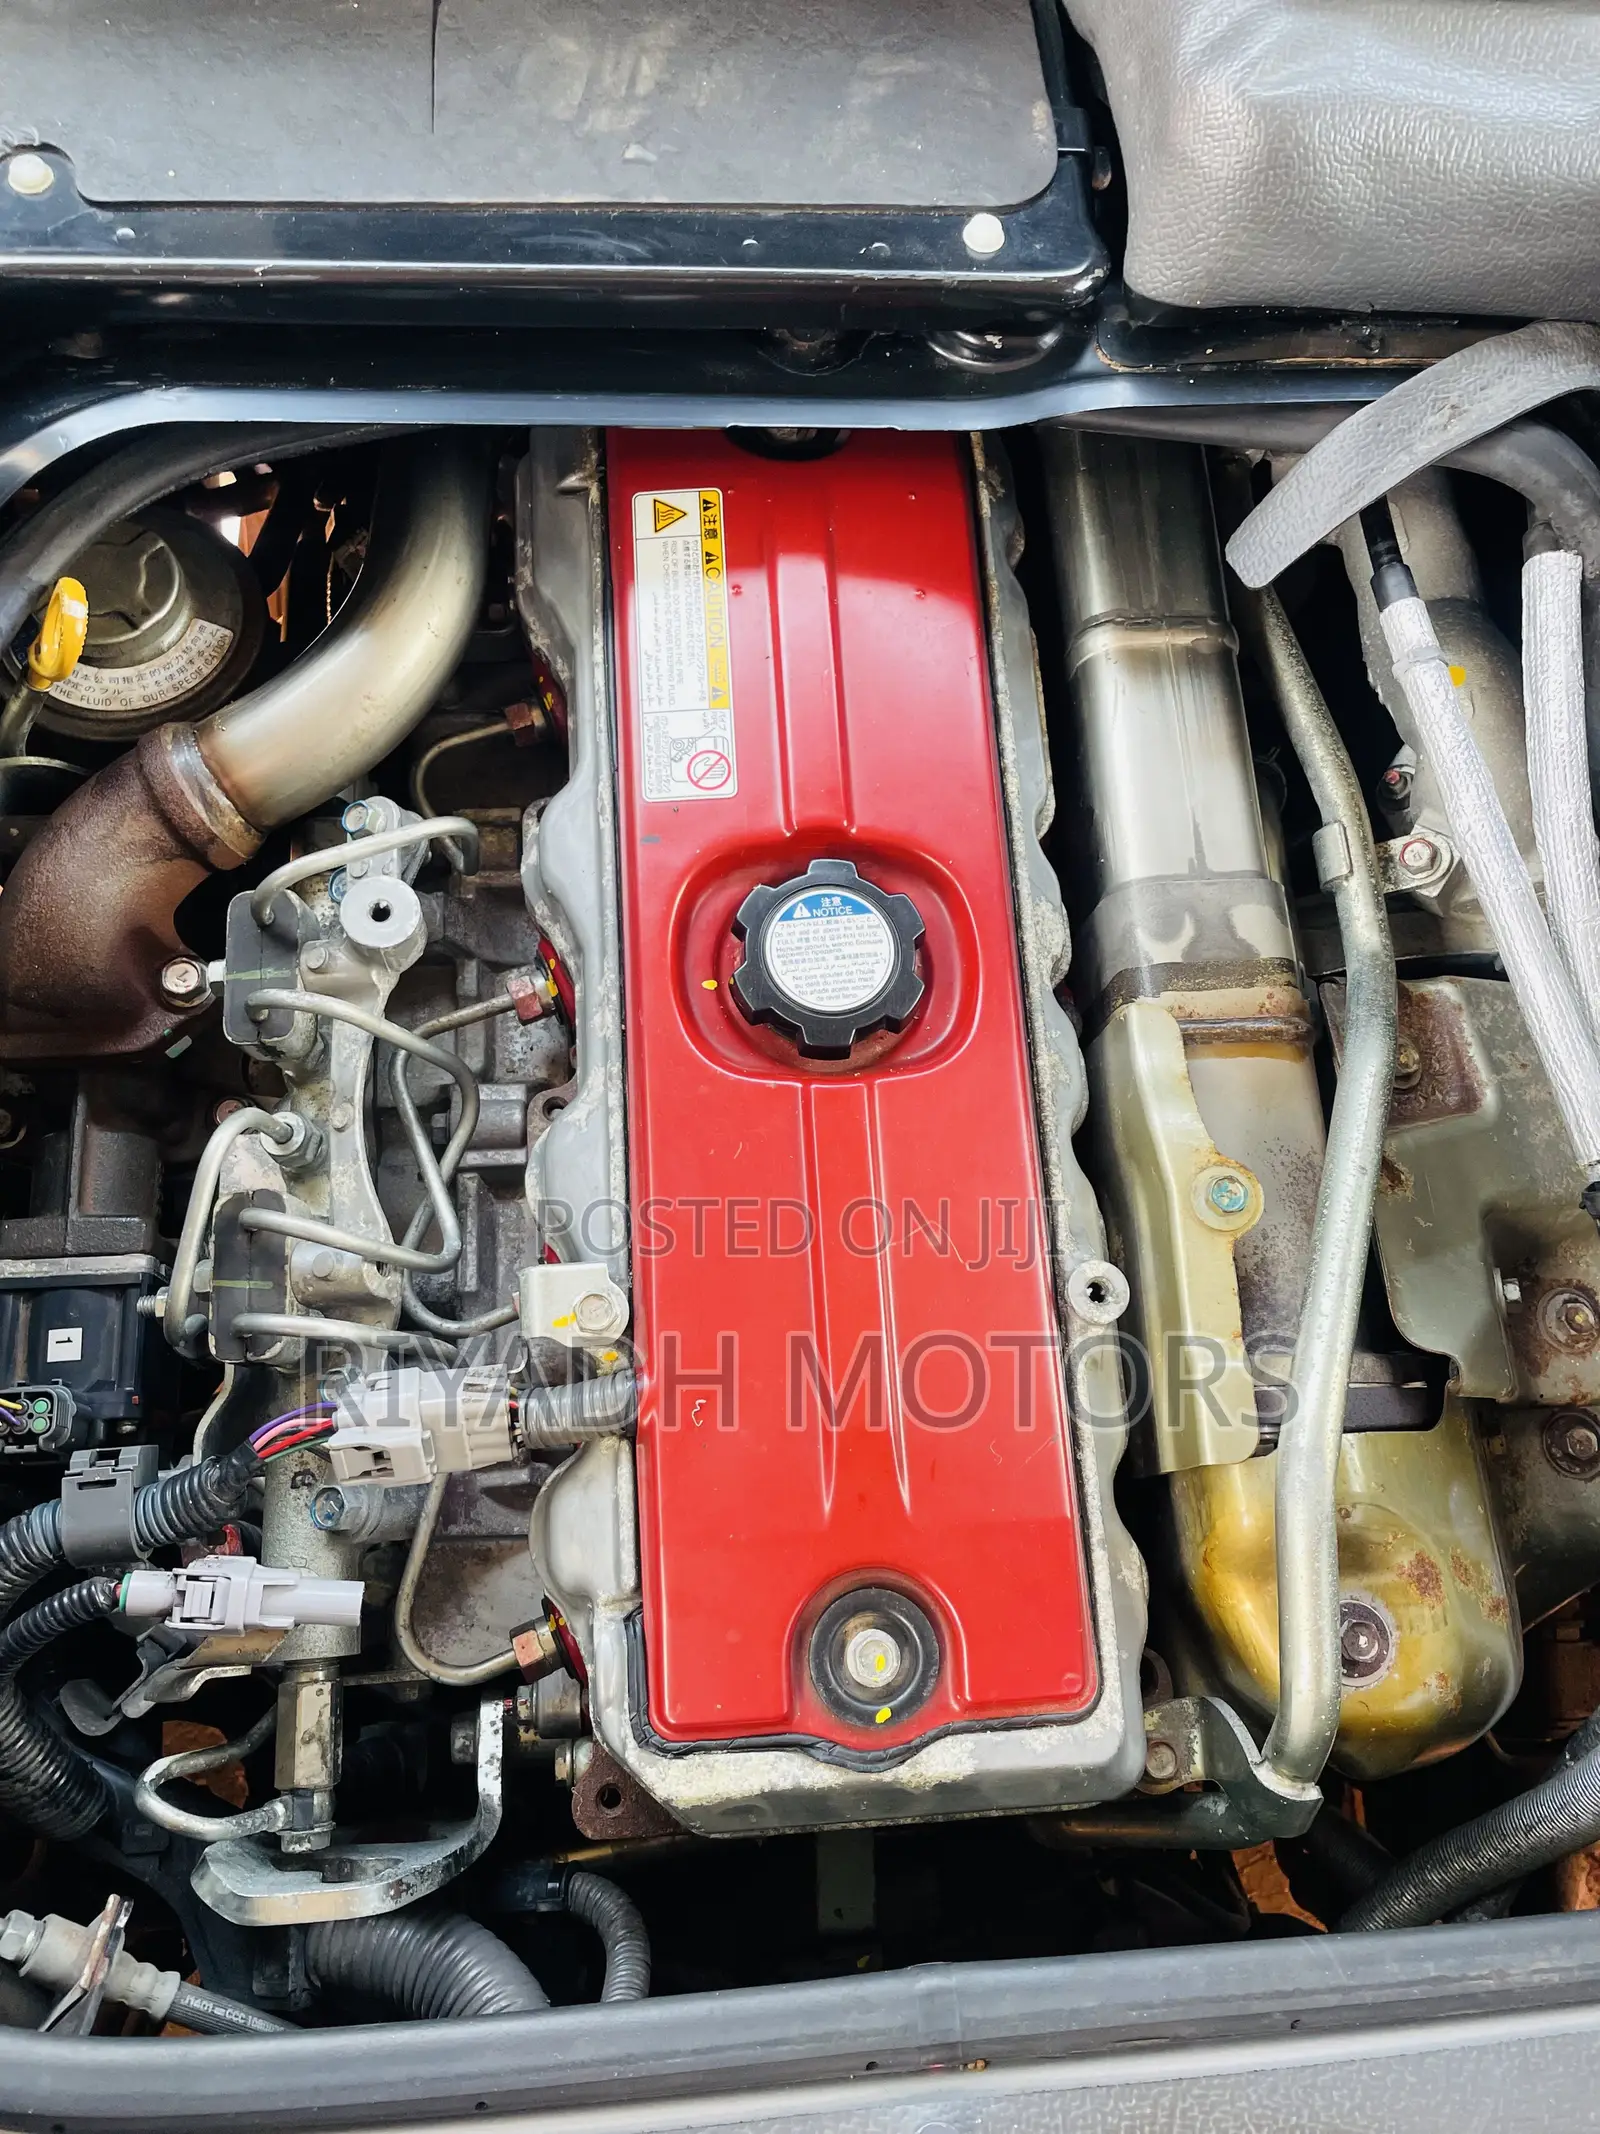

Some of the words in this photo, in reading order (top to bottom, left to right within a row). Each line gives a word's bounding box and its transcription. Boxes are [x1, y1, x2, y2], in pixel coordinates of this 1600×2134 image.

[703, 513, 718, 540] 注意
[705, 567, 725, 648] CAUTION
[54, 684, 73, 699] THE
[80, 694, 112, 707] FLUID
[120, 697, 134, 707] OF
[142, 689, 167, 703] OUR
[171, 632, 229, 692] SPECIFICATION
[813, 906, 853, 917] NOTICE
[821, 897, 842, 907] 注意
